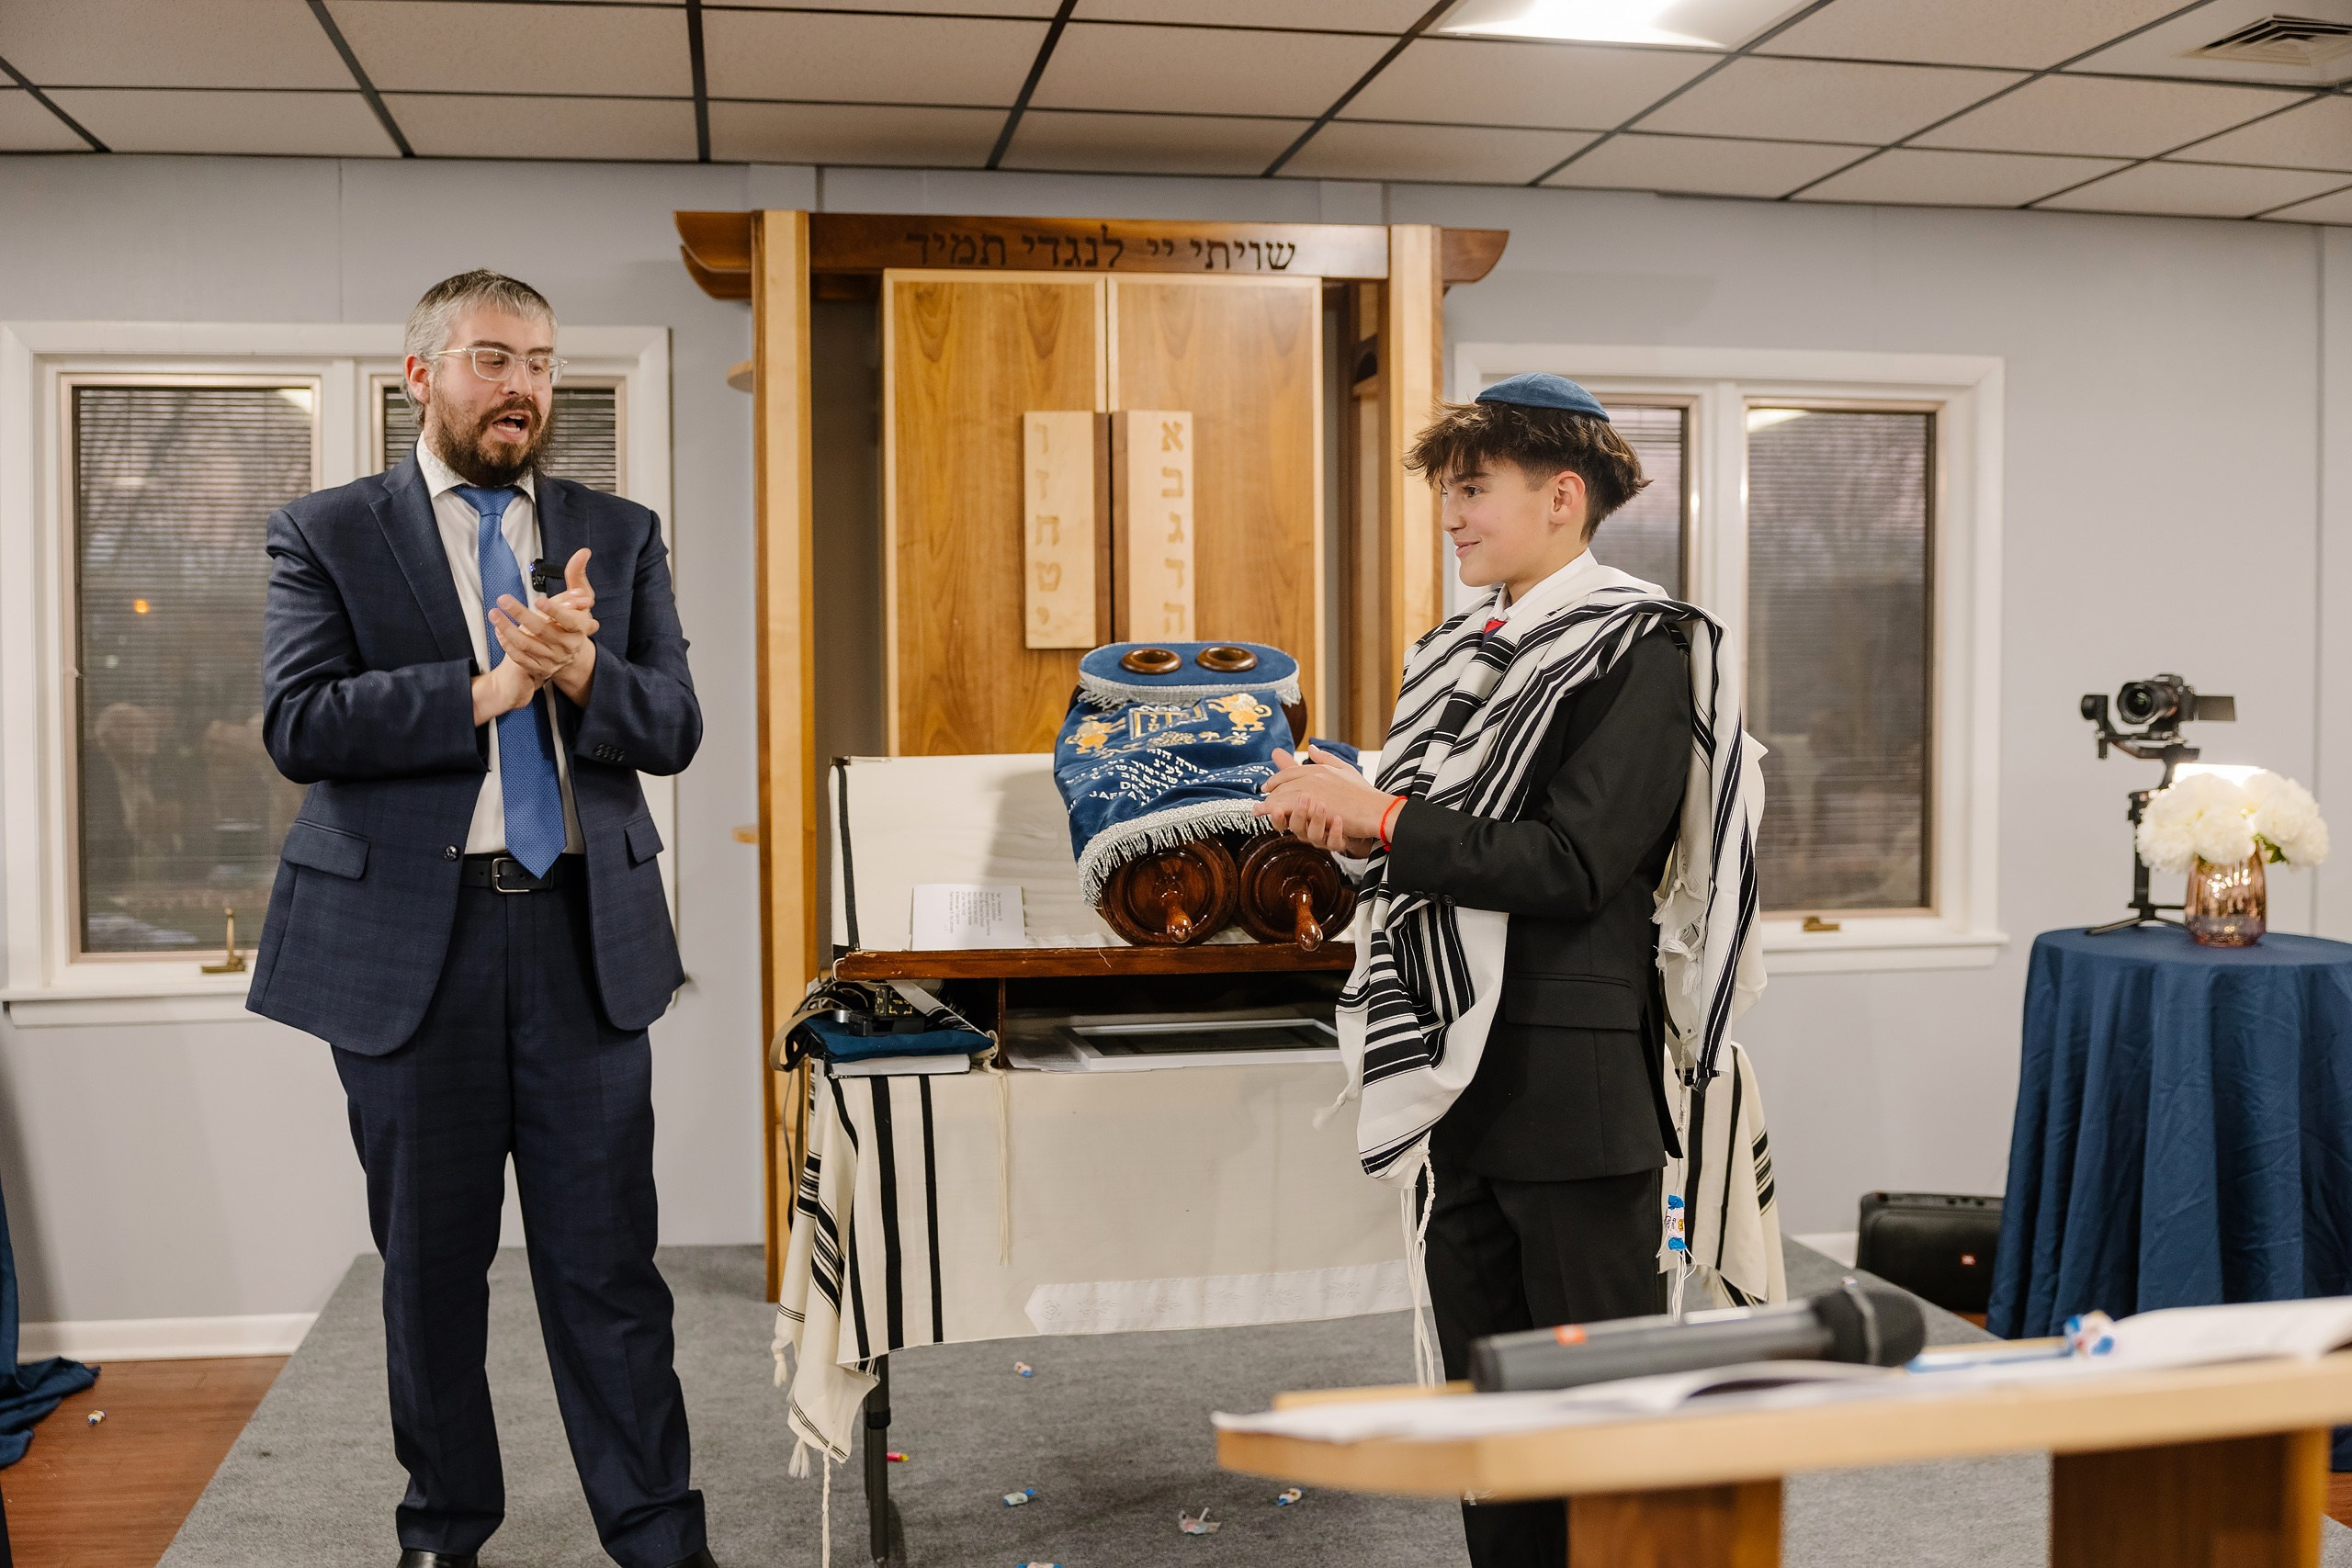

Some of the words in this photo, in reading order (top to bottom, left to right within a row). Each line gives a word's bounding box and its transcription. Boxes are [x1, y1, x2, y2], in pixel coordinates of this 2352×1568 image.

[905, 231, 1007, 267] תמיד
[1022, 223, 1125, 268] לנגדי
[1190, 239, 1295, 270] שויתי
